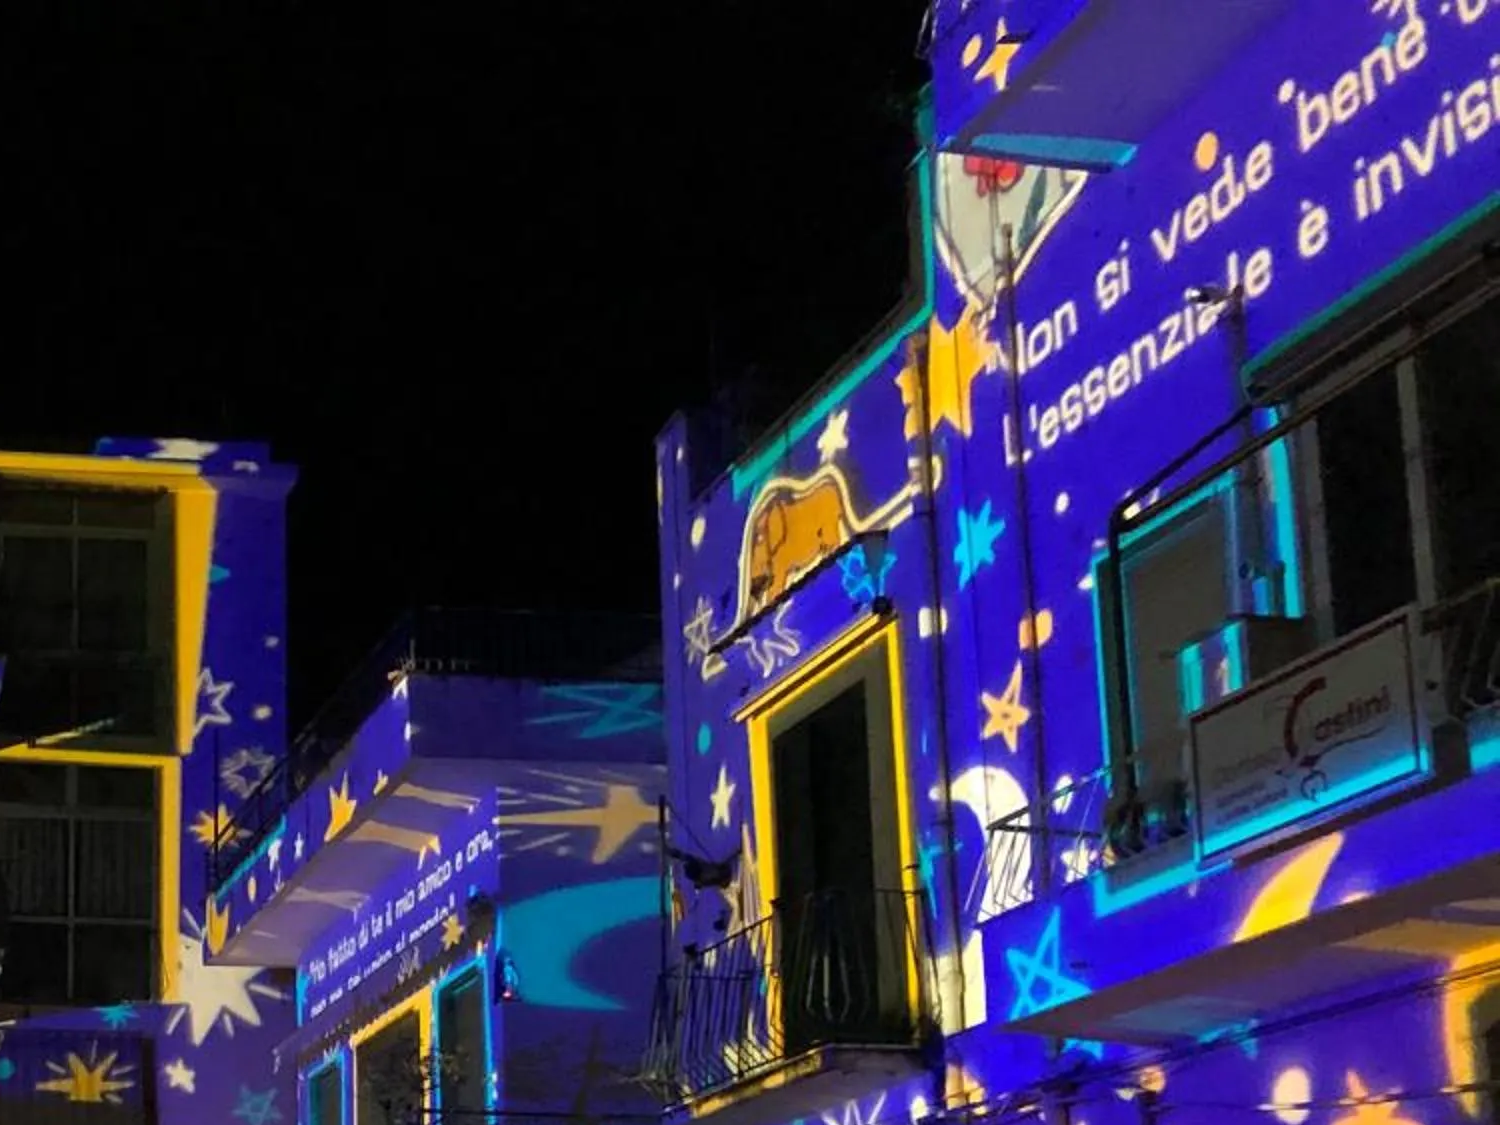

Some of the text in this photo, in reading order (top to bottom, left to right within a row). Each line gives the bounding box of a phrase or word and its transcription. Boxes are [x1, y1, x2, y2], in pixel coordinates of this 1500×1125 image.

[1094, 238, 1131, 313] si
[1150, 140, 1274, 263] vede
[1296, 15, 1428, 153] bene
[1002, 246, 1273, 467] L'essenziale
[1298, 198, 1330, 259] è
